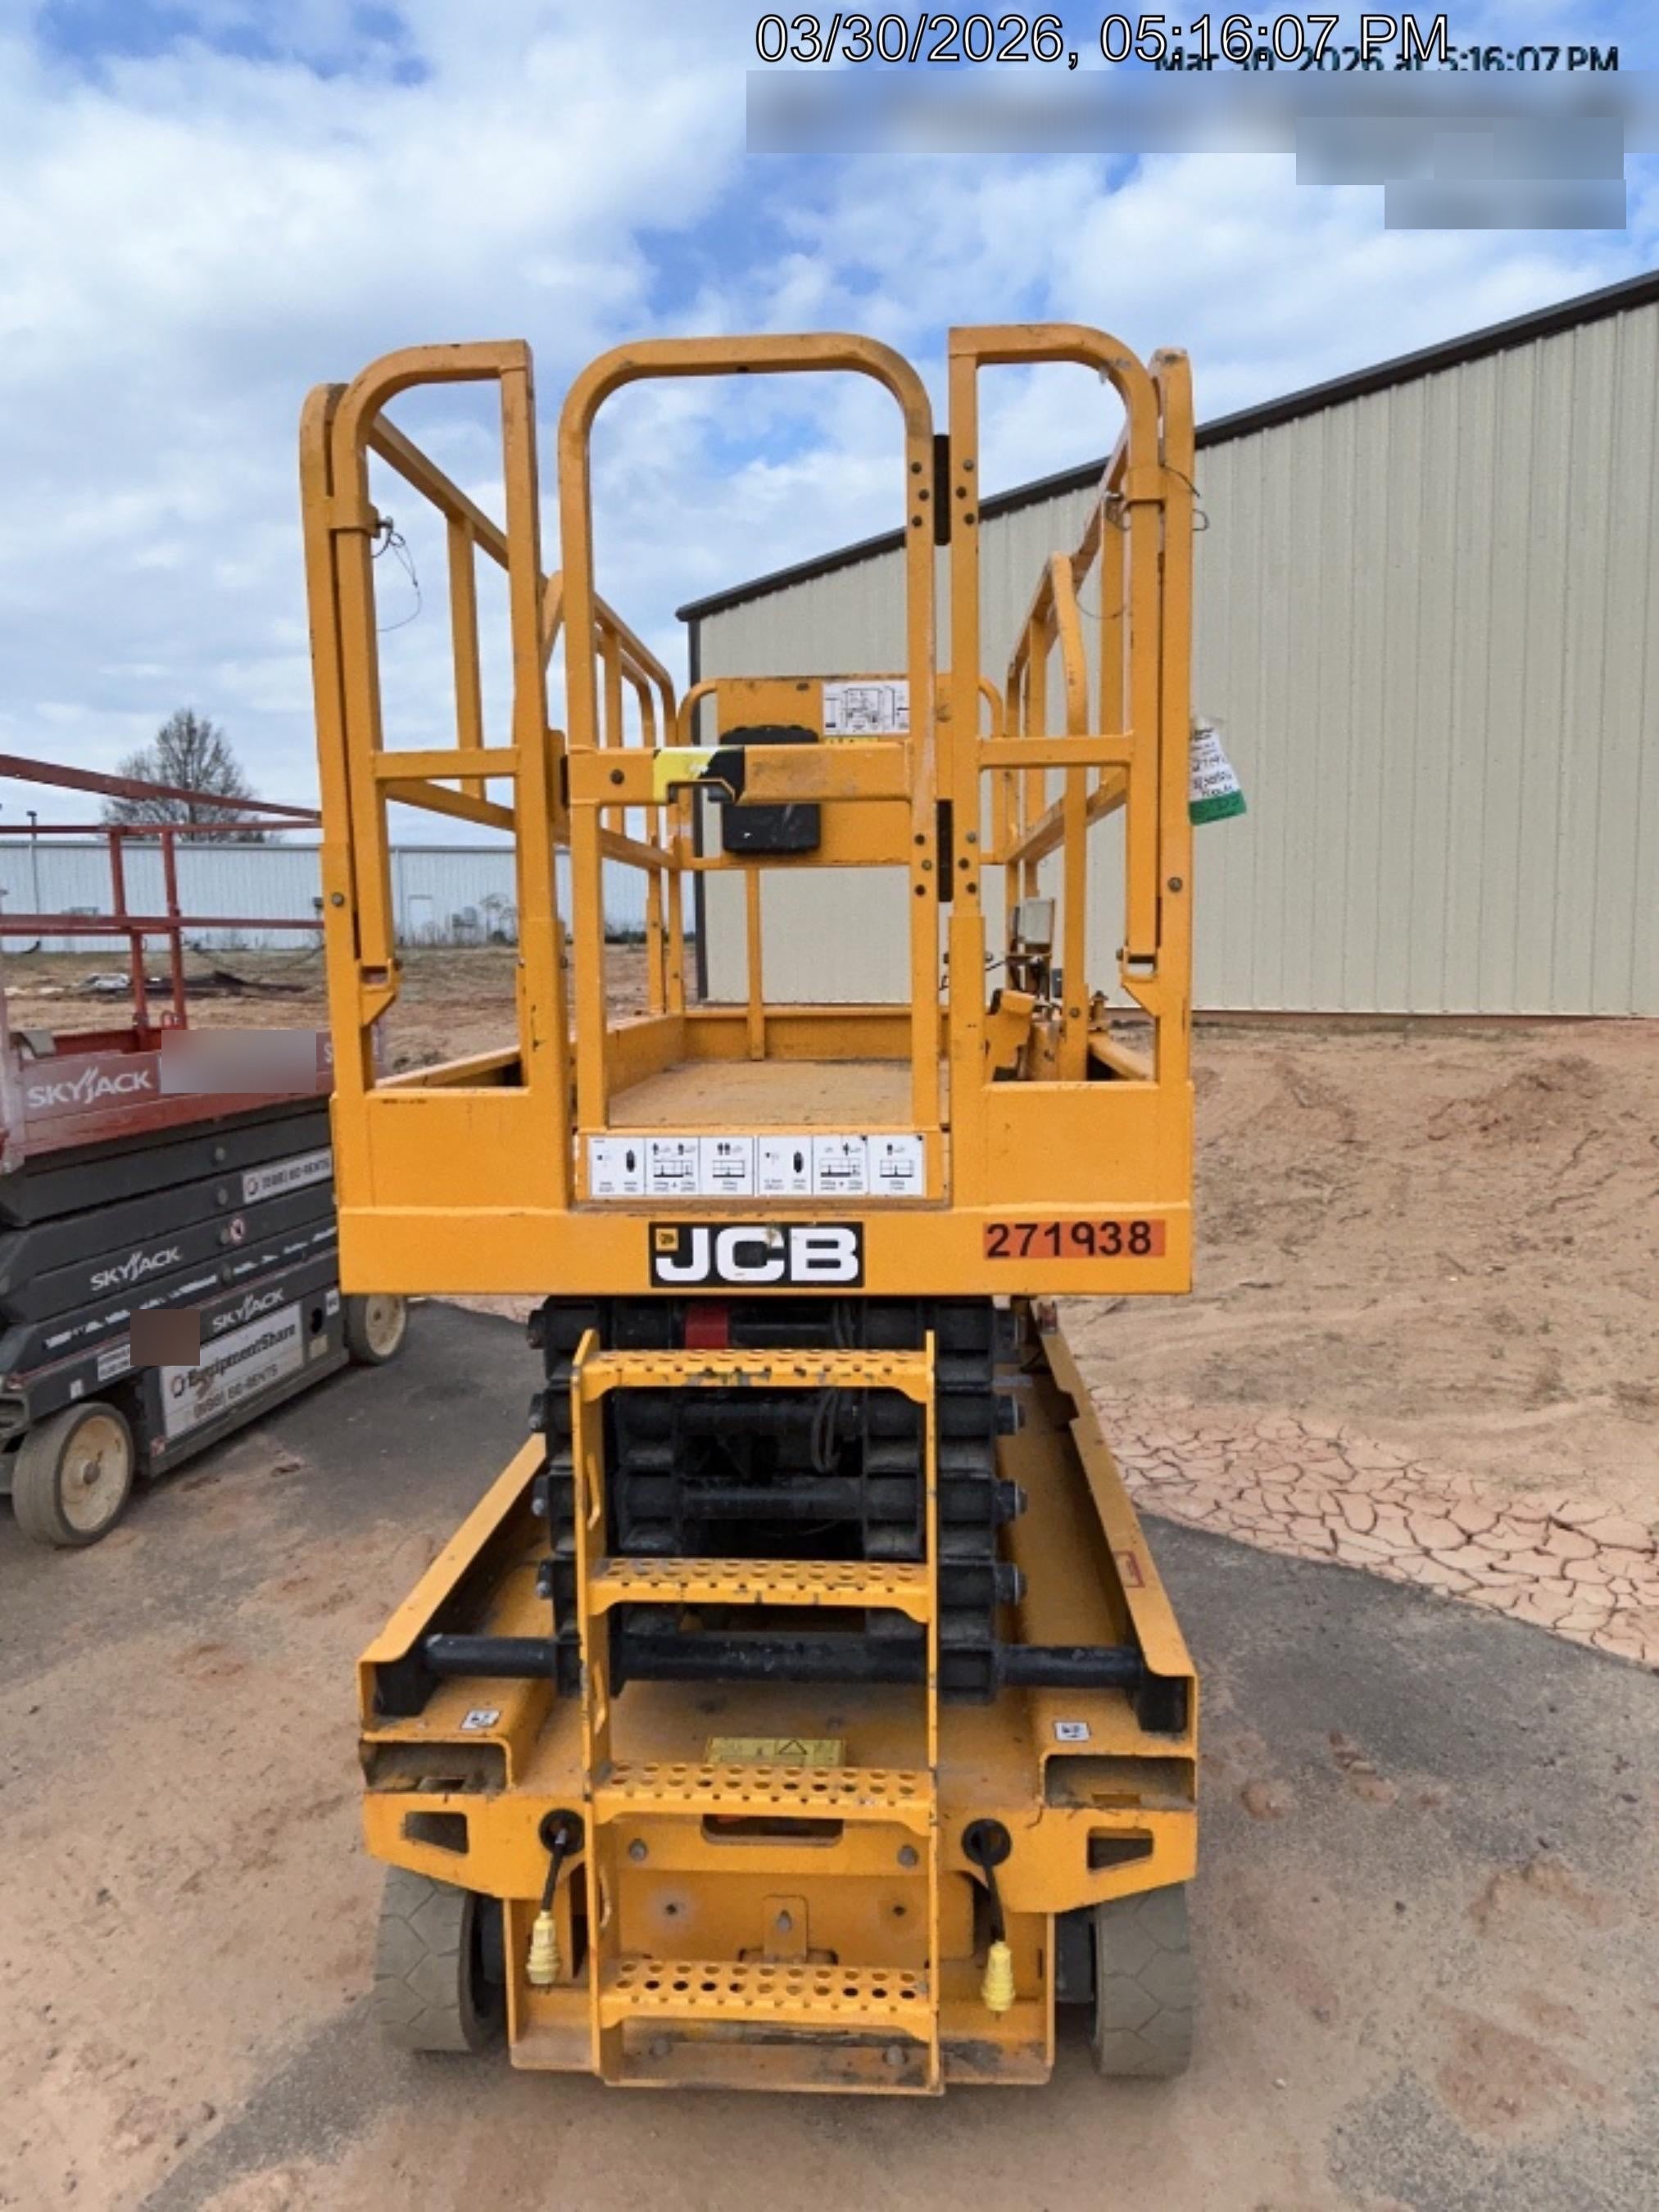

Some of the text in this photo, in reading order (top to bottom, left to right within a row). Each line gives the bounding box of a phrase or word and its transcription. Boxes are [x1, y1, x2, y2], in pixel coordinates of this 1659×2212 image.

[26, 1067, 152, 1107] SKYJACK
[655, 1226, 859, 1282] JCB
[986, 1221, 1152, 1258] 271938
[90, 1246, 183, 1291] SKYJACK
[212, 1288, 284, 1330] SKYJACK
